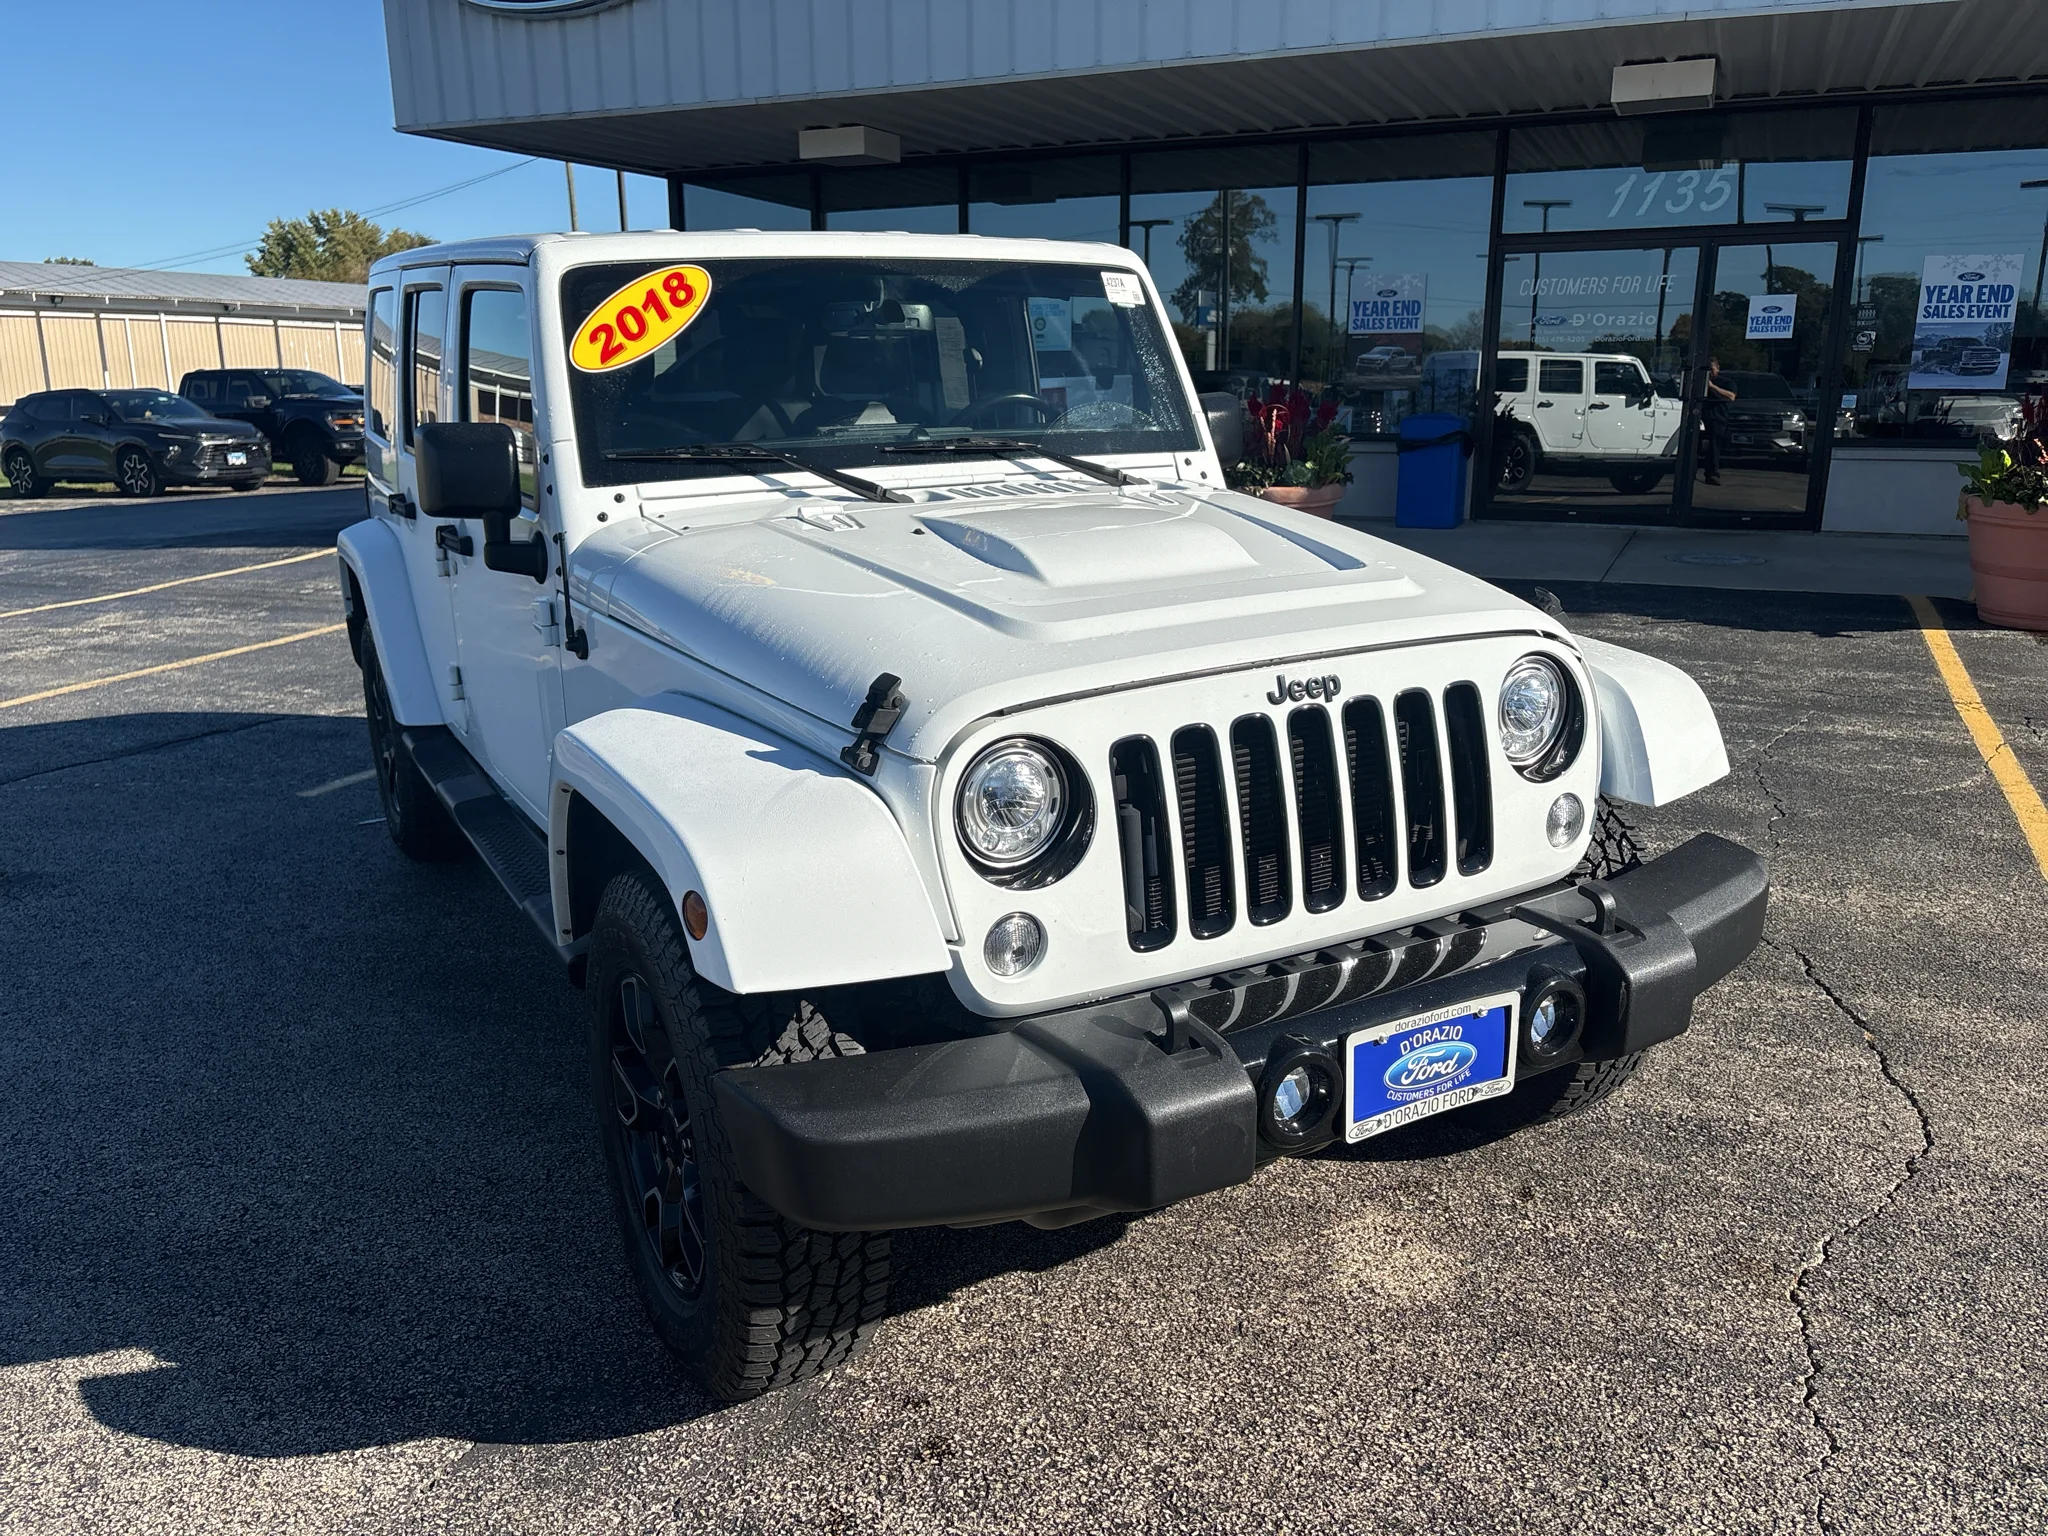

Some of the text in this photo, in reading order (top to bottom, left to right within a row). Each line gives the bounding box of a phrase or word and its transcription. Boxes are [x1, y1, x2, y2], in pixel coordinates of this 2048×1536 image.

[1607, 169, 1738, 218] 1135
[1519, 274, 1676, 296] CUSTOMERS FOR LIFE
[1961, 273, 1980, 281] Ford
[1925, 284, 2015, 304] YEAR END
[1353, 299, 1421, 317] YEAR END
[1922, 304, 2011, 319] SALES EVENT
[589, 272, 696, 366] 2018
[1352, 317, 1420, 331] SALES EVENT
[1539, 311, 1657, 326] Ford D'Orazio
[1750, 315, 1792, 325] YEAR END
[1749, 325, 1769, 333] SALES
[1266, 673, 1341, 705] Jeep
[1394, 1004, 1472, 1033] dorazioford.com
[1400, 1025, 1463, 1055] D'ORAZIO
[1401, 1048, 1461, 1085] Ford
[1386, 1068, 1472, 1101] CUSTOMERS FOR LIFE
[1484, 1080, 1505, 1094] Ford
[1383, 1086, 1475, 1129] D'ORAZIO FORD
[1355, 1122, 1375, 1137] Ford
